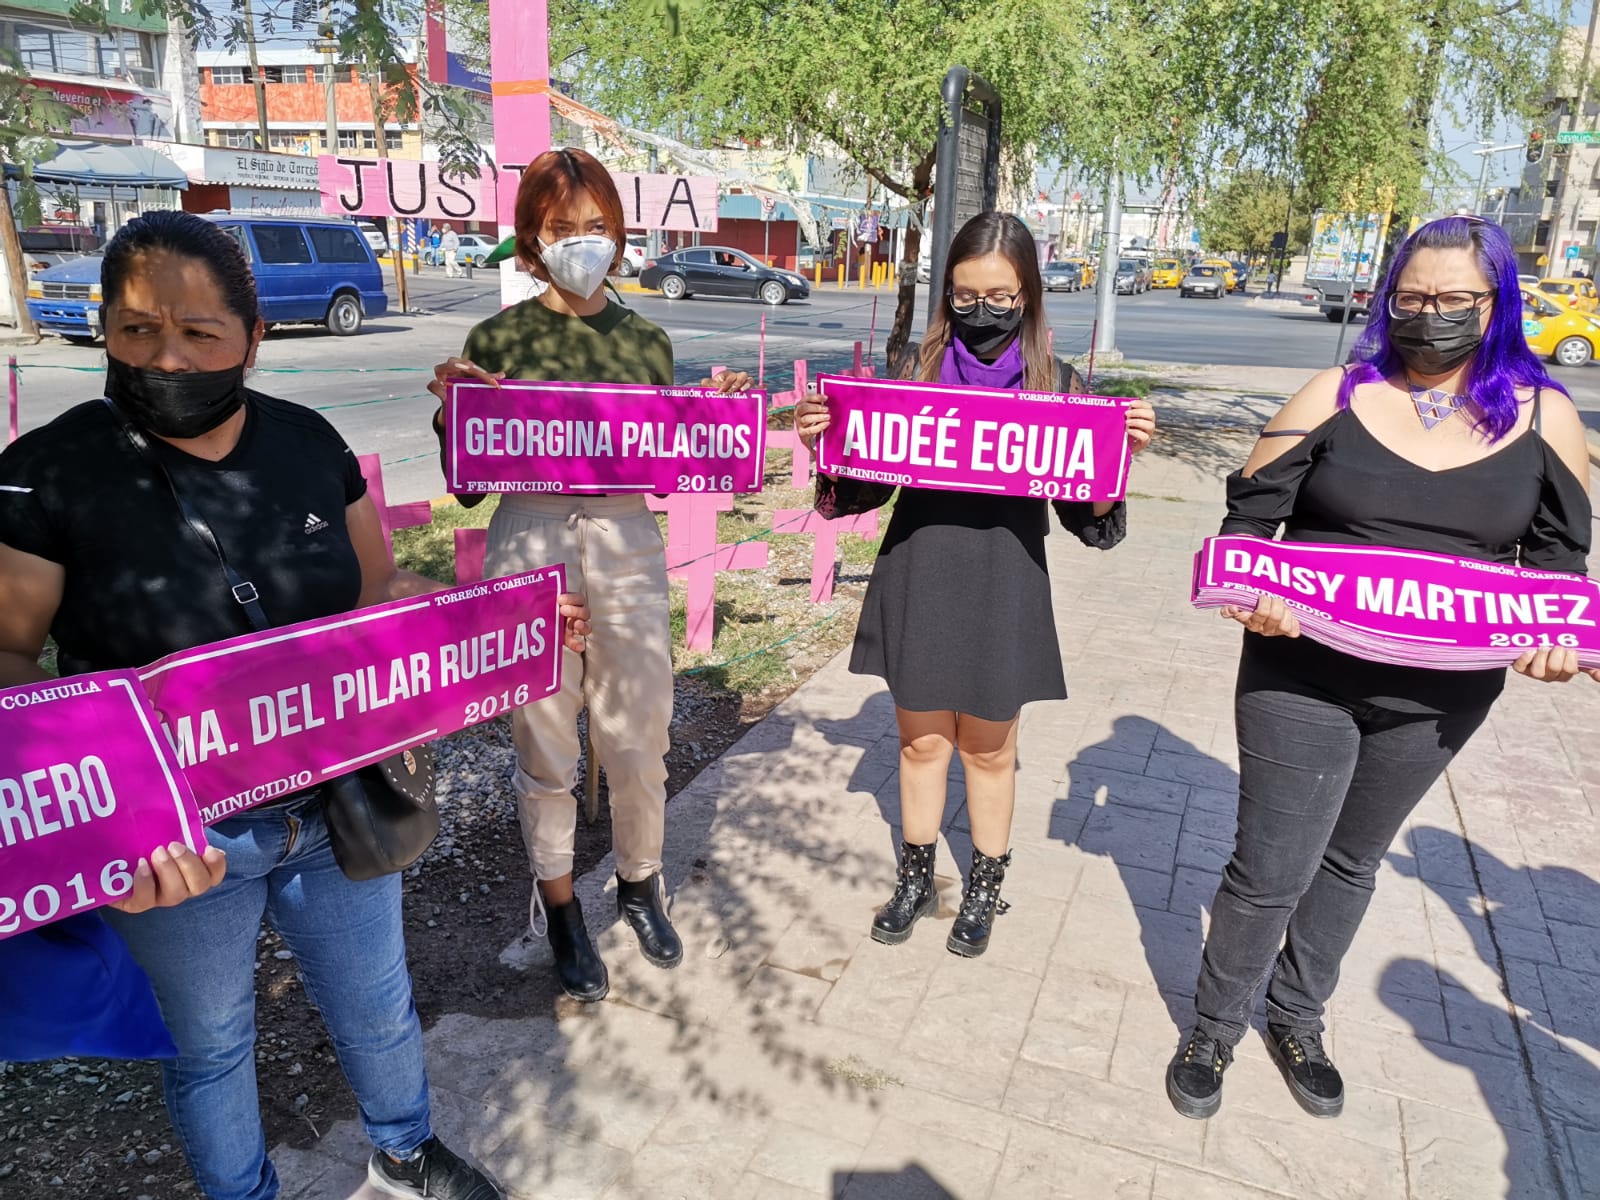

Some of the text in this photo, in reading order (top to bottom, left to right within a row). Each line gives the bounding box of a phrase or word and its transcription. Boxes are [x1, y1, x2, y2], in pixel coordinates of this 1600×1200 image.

[236, 157, 319, 176] El Siglo de Torreó
[337, 157, 701, 229] JUSIA
[660, 388, 704, 399] TORREÓN,
[1018, 392, 1117, 407] TORREÓN, COAHUILA
[465, 417, 751, 460] GEORGINA PALACIOS
[843, 405, 1096, 480] AIDÉÉ EGUIA
[466, 480, 564, 493] FEMINICIDIO
[677, 474, 734, 492] 2016
[830, 463, 913, 485] FEMINICIDIO
[1028, 479, 1092, 501] 2016
[1224, 549, 1597, 627] DAISY MARTINEZ
[1458, 560, 1583, 583] TORREÓN, COAHUILA
[434, 572, 545, 606] TORREÓN, COAHUILA
[1222, 581, 1334, 621] FEMINCIDIO
[1489, 632, 1580, 648] 2016
[1, 680, 103, 711] COAHUILA
[161, 617, 547, 770] MA. DEL PILAR RUELAS
[463, 683, 530, 726] 2016
[0, 754, 117, 849] RERO
[200, 769, 313, 824] MINICIDIO
[0, 858, 134, 934] 2016
